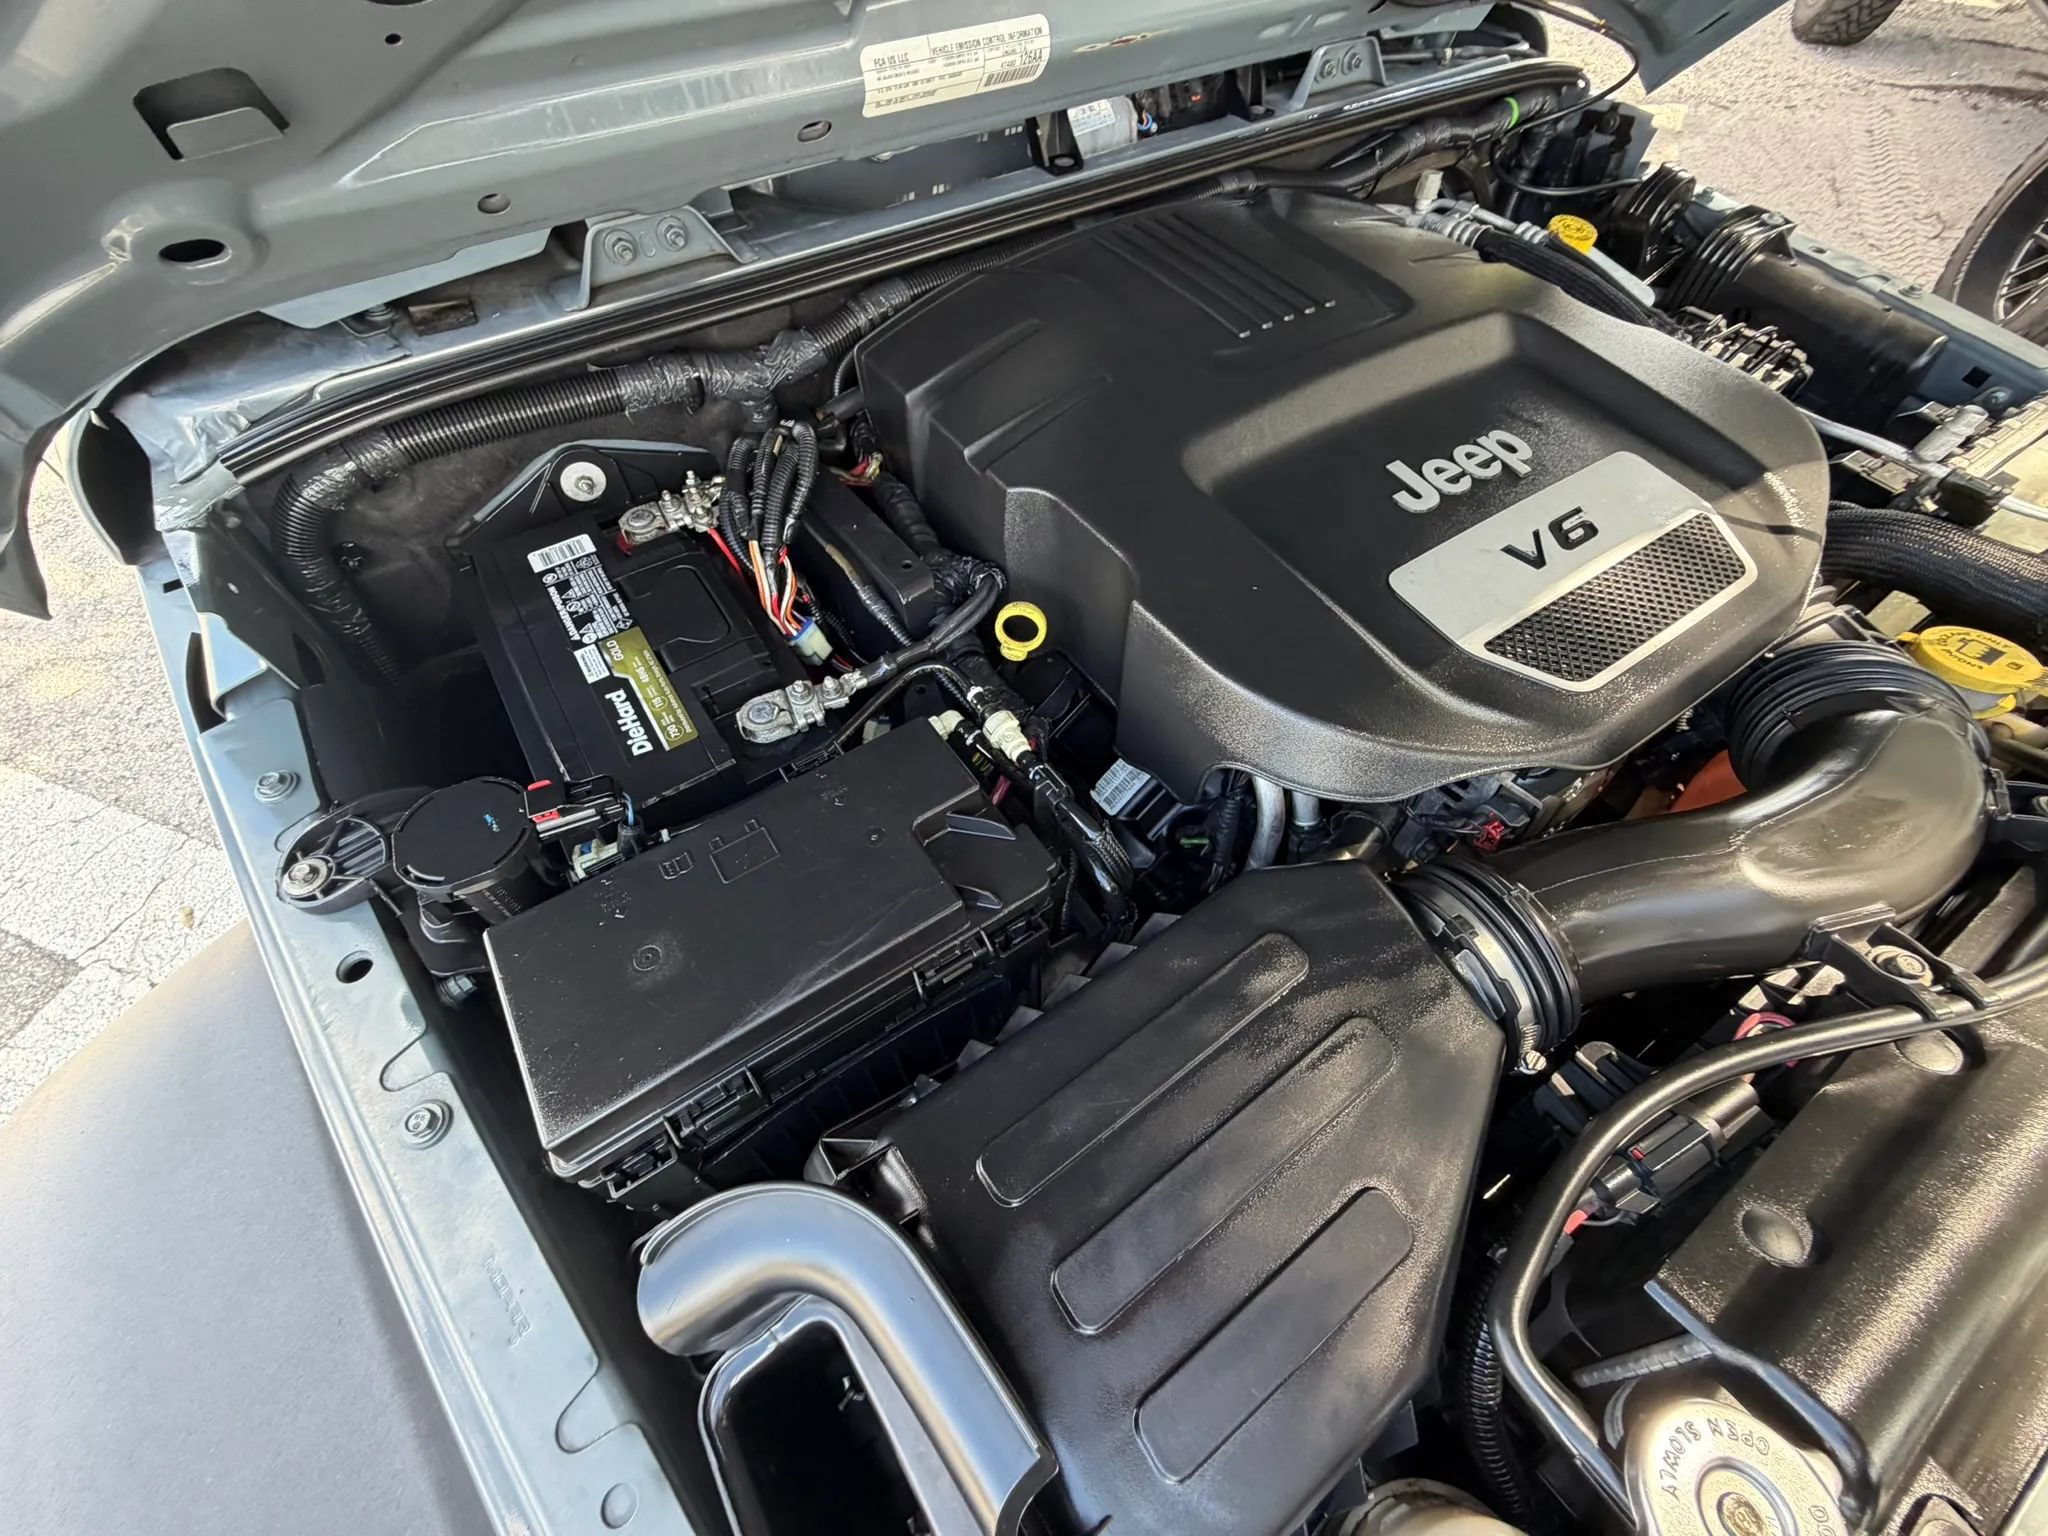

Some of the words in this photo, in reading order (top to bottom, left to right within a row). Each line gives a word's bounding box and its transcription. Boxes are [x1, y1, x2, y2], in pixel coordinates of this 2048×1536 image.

[873, 57, 886, 68] FCA
[886, 55, 897, 65] US
[896, 52, 909, 63] LLC
[930, 43, 955, 56] VEHICLE
[954, 37, 981, 51] EMISSION
[981, 32, 1005, 46] CONTROL
[1006, 25, 1043, 41] INFORMATION
[1385, 429, 1533, 513] Jeep
[1500, 506, 1600, 570] V6
[606, 639, 625, 662] GOLD
[604, 688, 654, 757] DieHard
[1658, 1421, 1702, 1501] SLOWLY
[1706, 1418, 1770, 1456] OPEN
